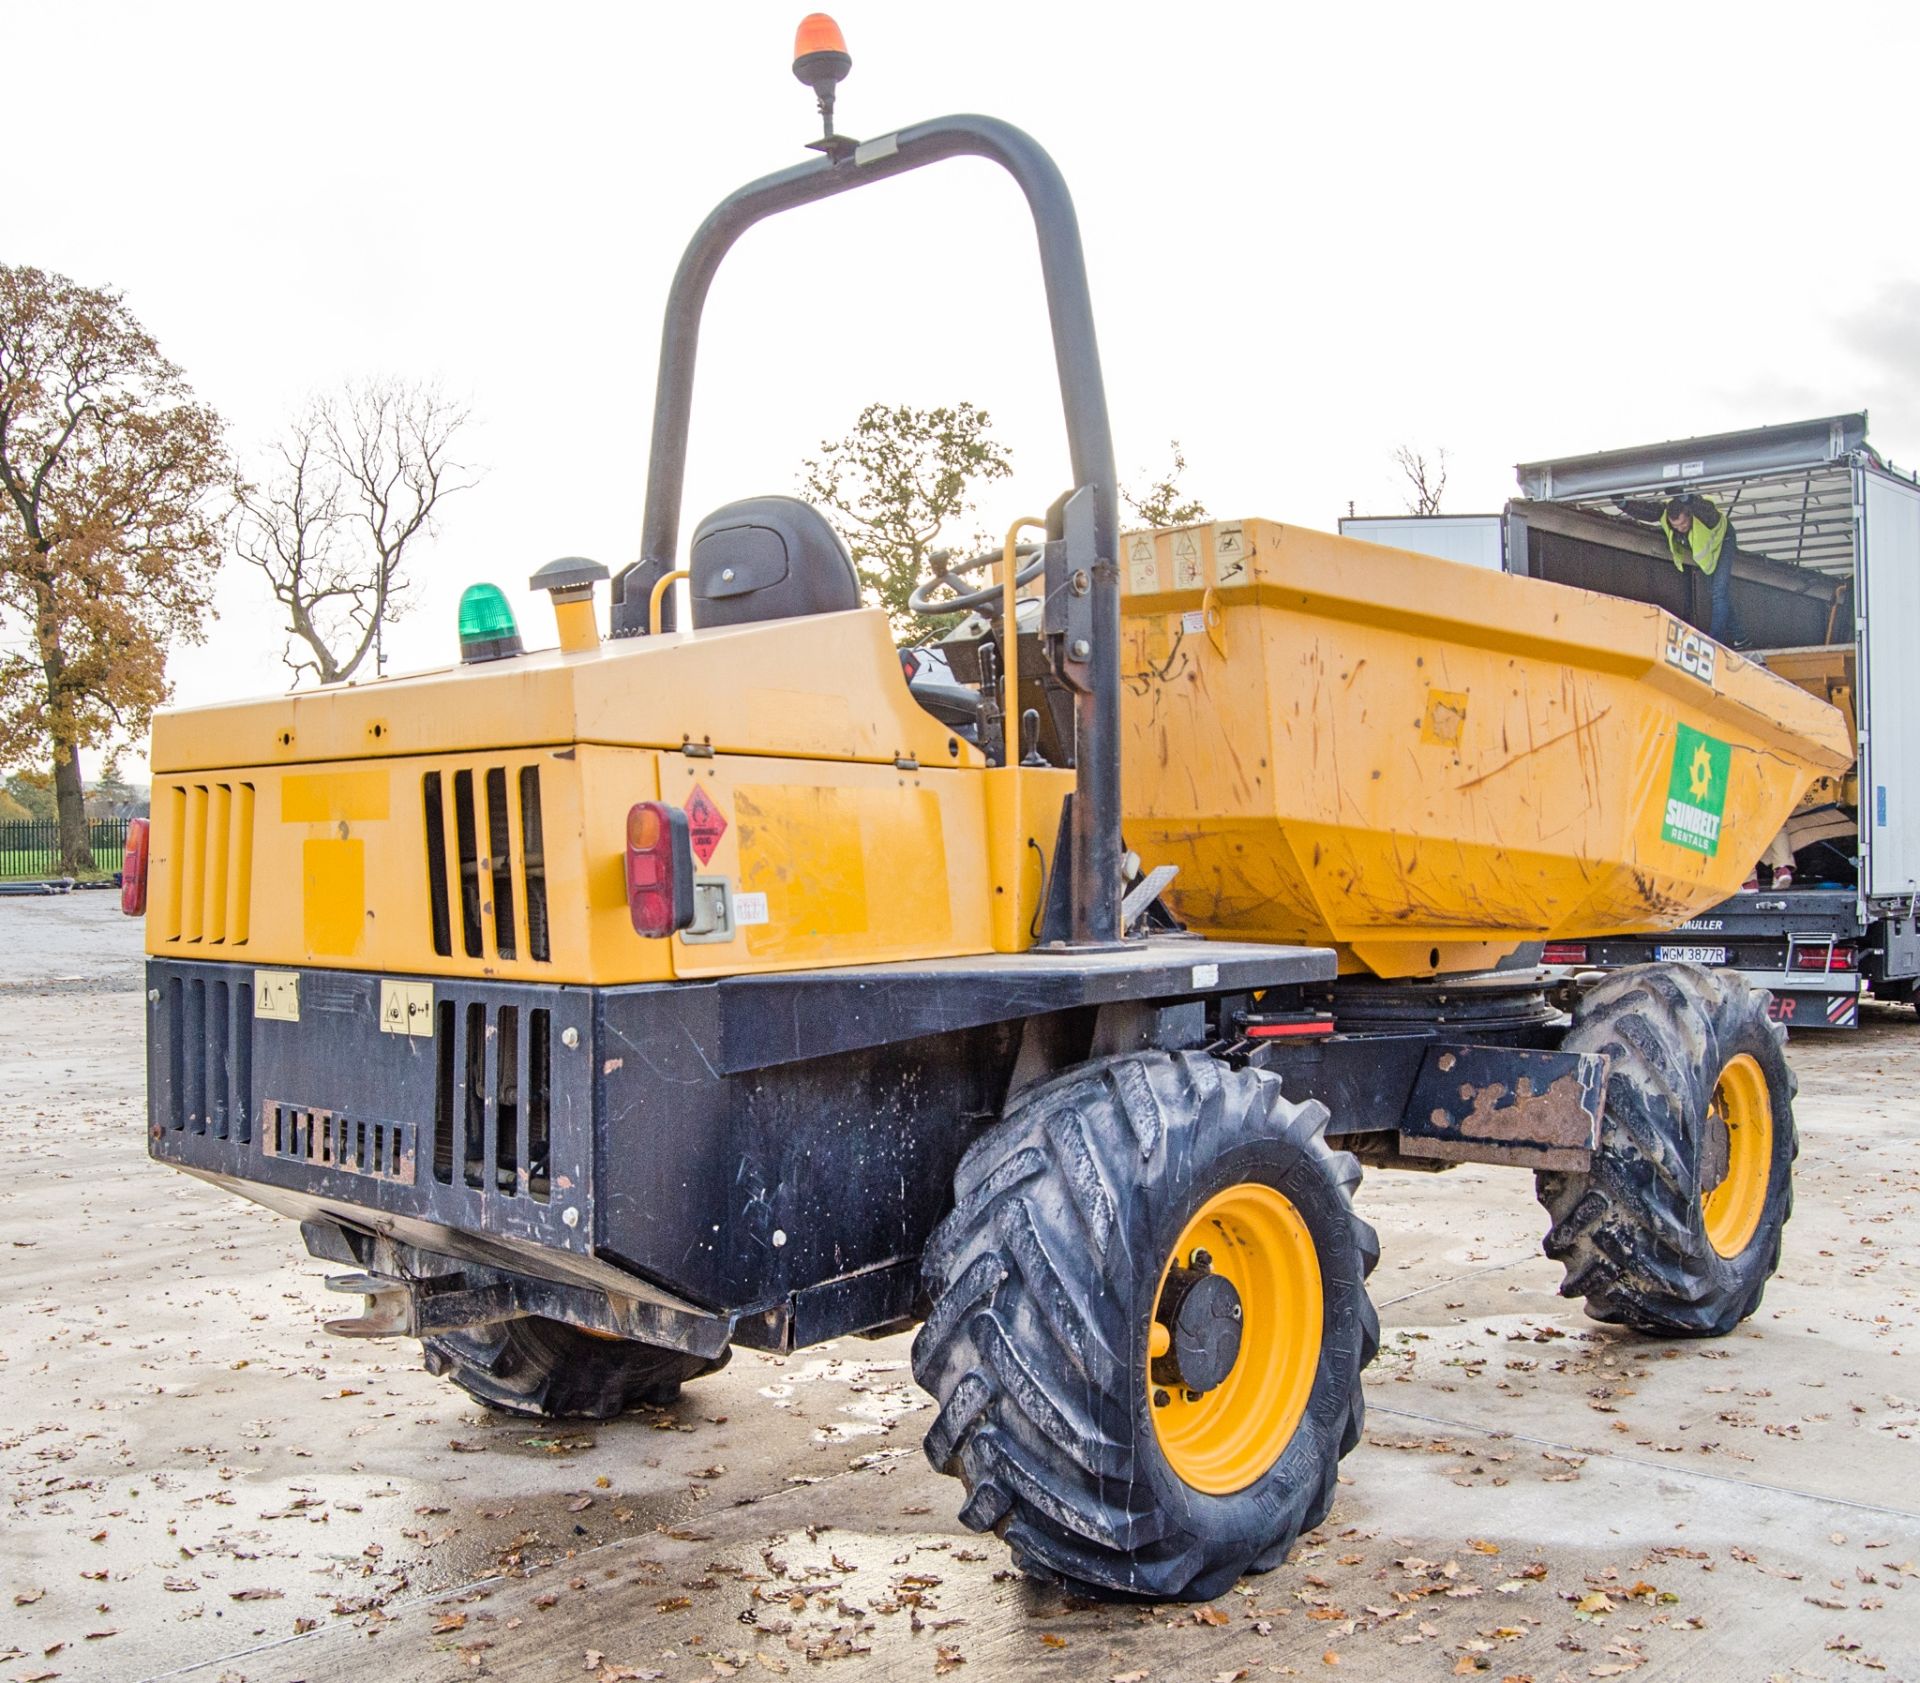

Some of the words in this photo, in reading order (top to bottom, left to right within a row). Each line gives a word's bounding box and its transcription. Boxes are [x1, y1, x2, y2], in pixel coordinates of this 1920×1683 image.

[1665, 625, 1715, 682] JCB
[1665, 798, 1720, 840] SUNBELT
[1671, 828, 1709, 849] RENTALS
[1676, 919, 1723, 930] MÜLLER
[1661, 948, 1684, 960] WGM
[1688, 948, 1724, 960] 3877R
